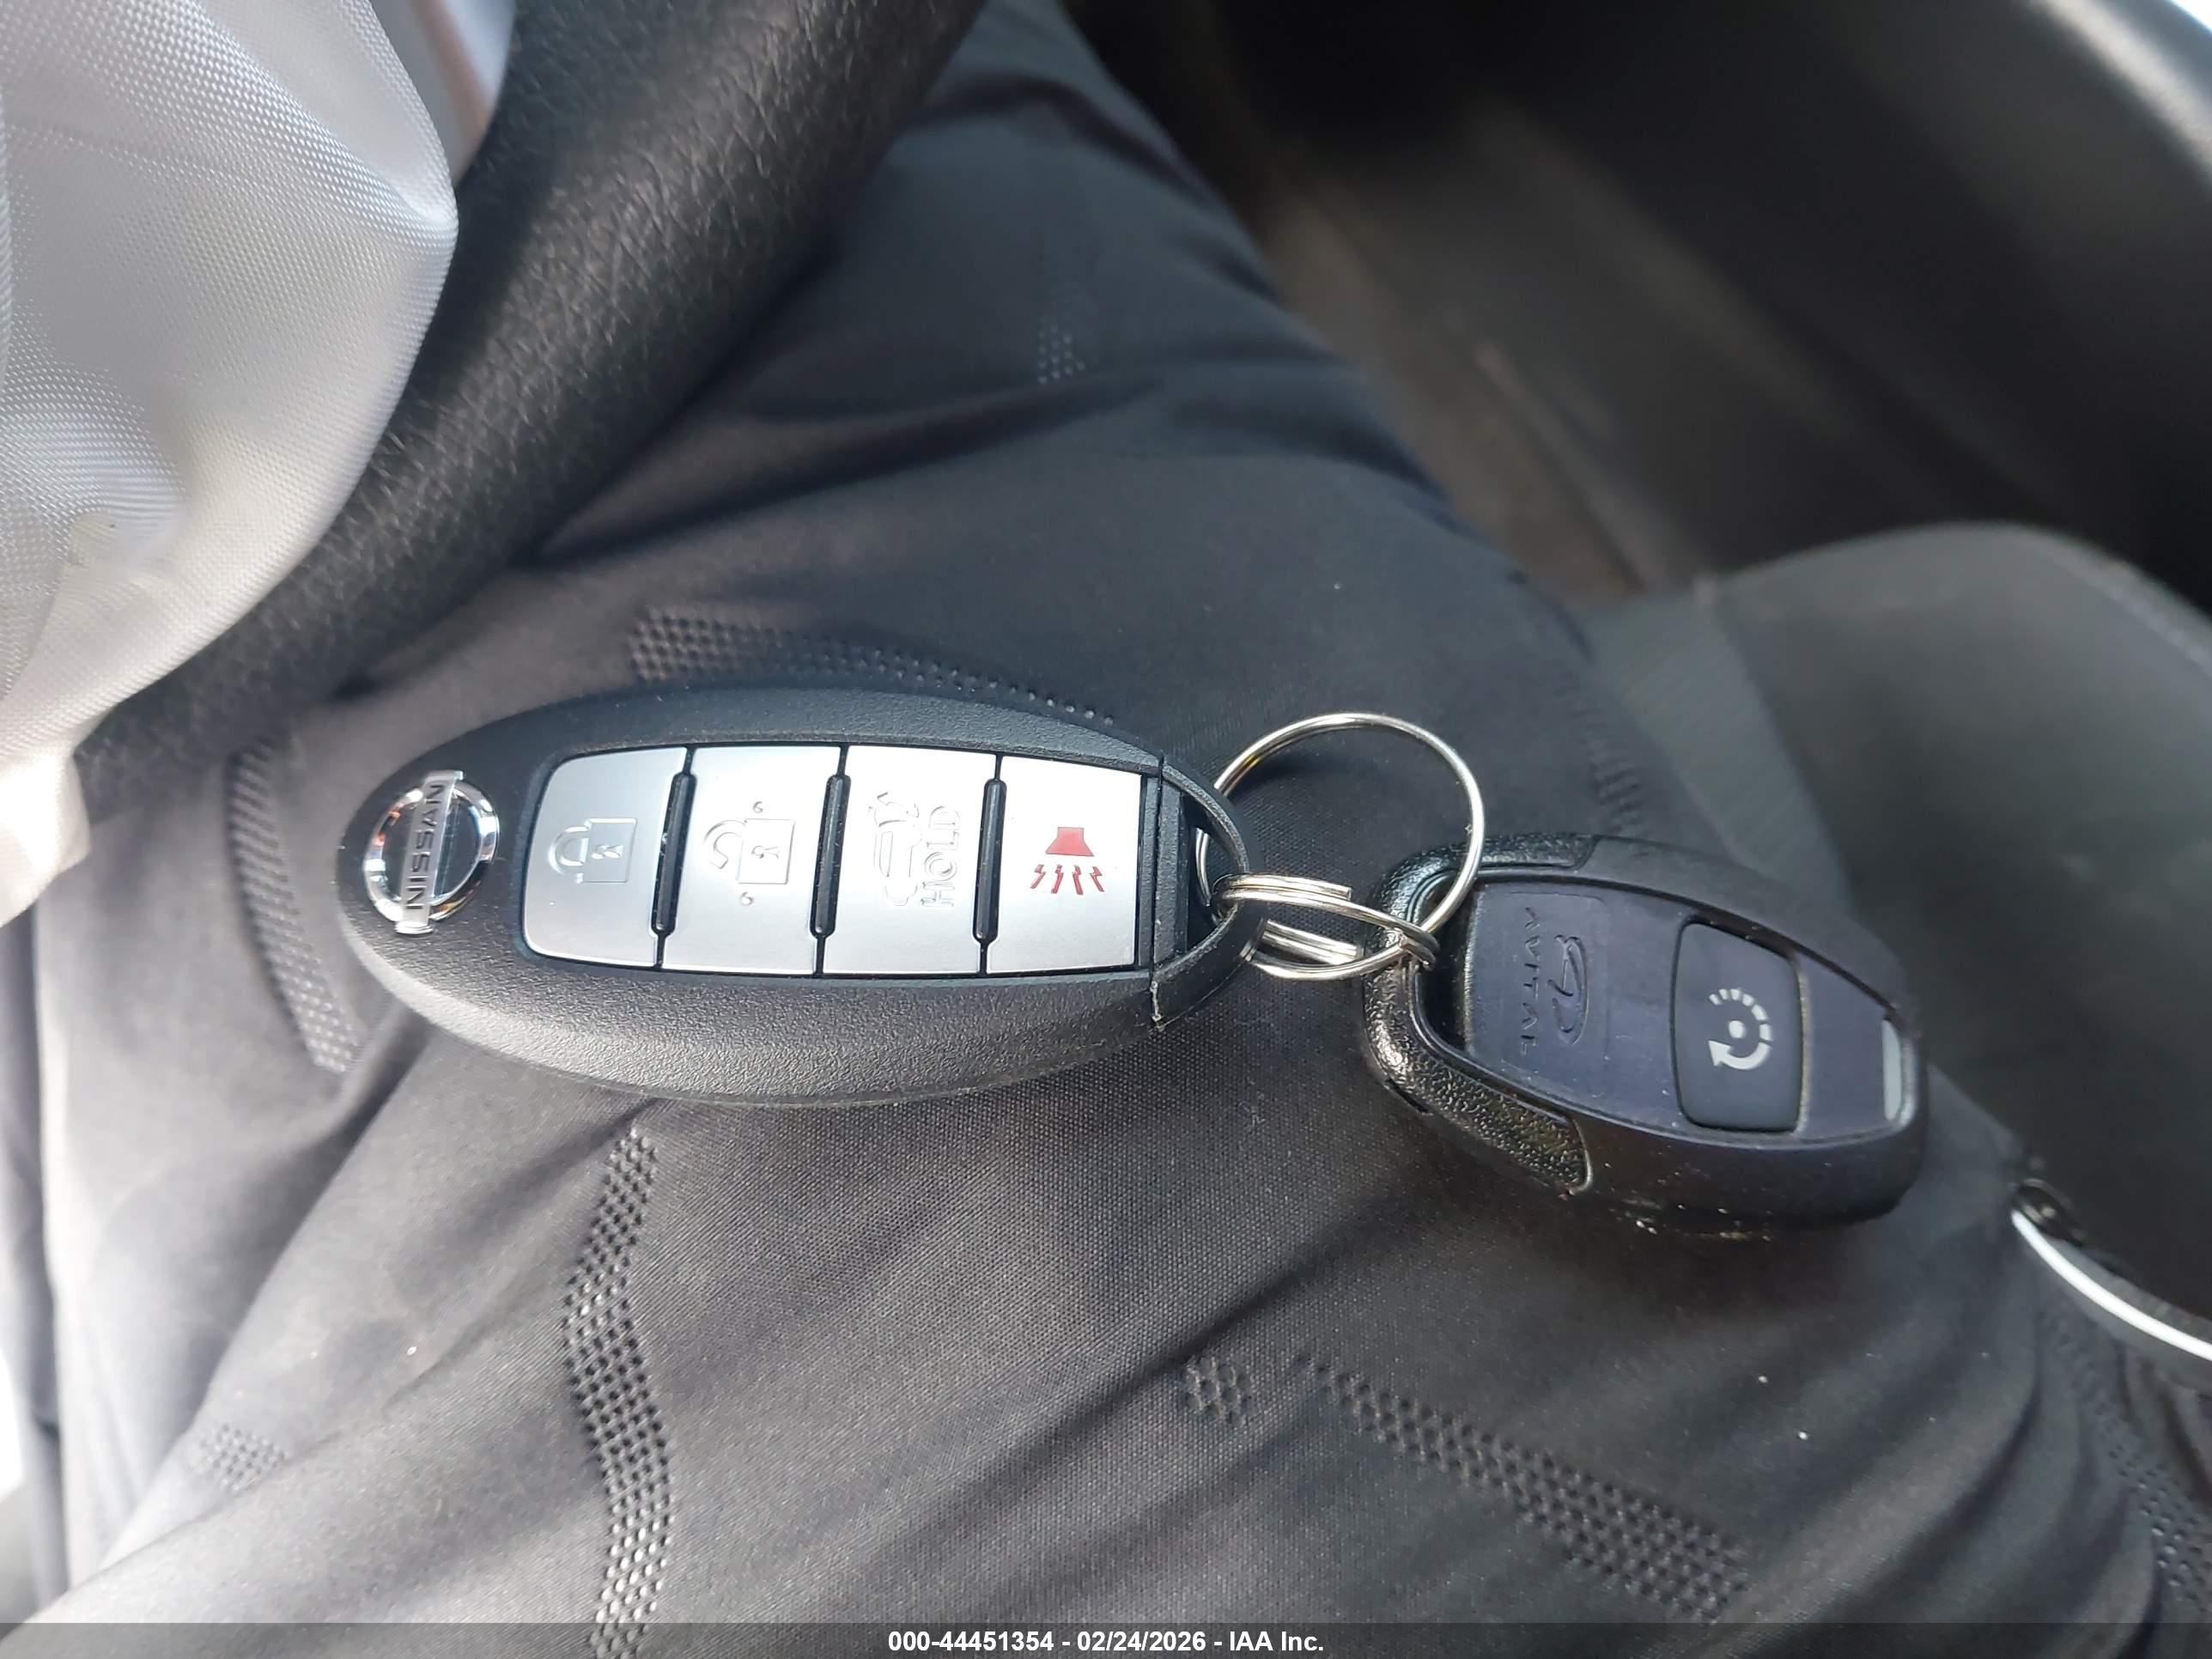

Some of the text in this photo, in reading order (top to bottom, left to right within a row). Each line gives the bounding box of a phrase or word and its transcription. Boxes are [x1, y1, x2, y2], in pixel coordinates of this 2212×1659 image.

[405, 782, 445, 910] NISSAN
[920, 805, 961, 907] HOLD
[1520, 906, 1540, 1055] AVITAL
